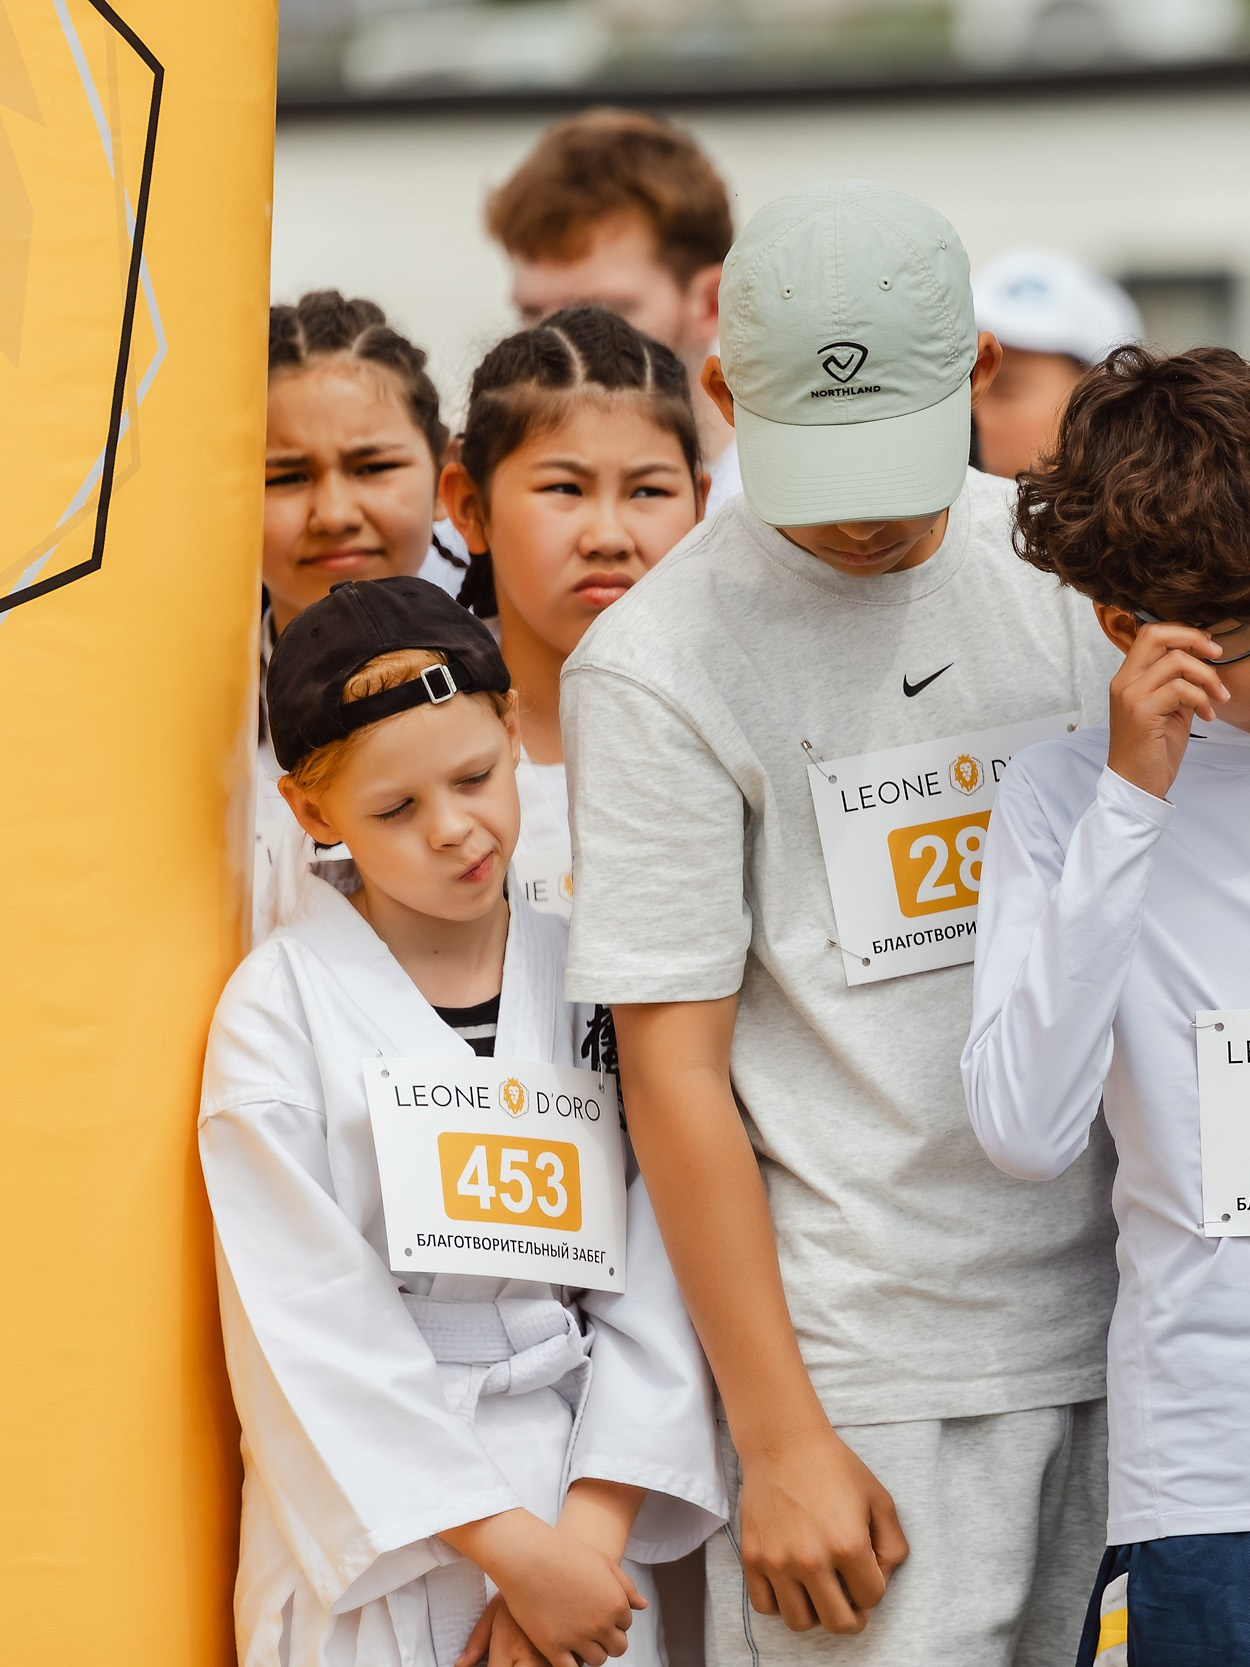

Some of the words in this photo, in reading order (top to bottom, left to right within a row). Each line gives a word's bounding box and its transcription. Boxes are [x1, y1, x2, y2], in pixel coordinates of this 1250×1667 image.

[811, 385, 881, 398] NORTHLAND
[841, 771, 942, 813] LEONE
[909, 825, 988, 904] 28
[872, 920, 977, 954] БЛАГОТВОРИ
[394, 1085, 491, 1109] LEONE
[536, 1091, 601, 1122] D'ORO
[456, 1145, 568, 1218] 453
[416, 1232, 569, 1260] БЛАГОТВОРИТЕЛЬНЫЙ
[572, 1247, 606, 1264] ЗАБЕГ
